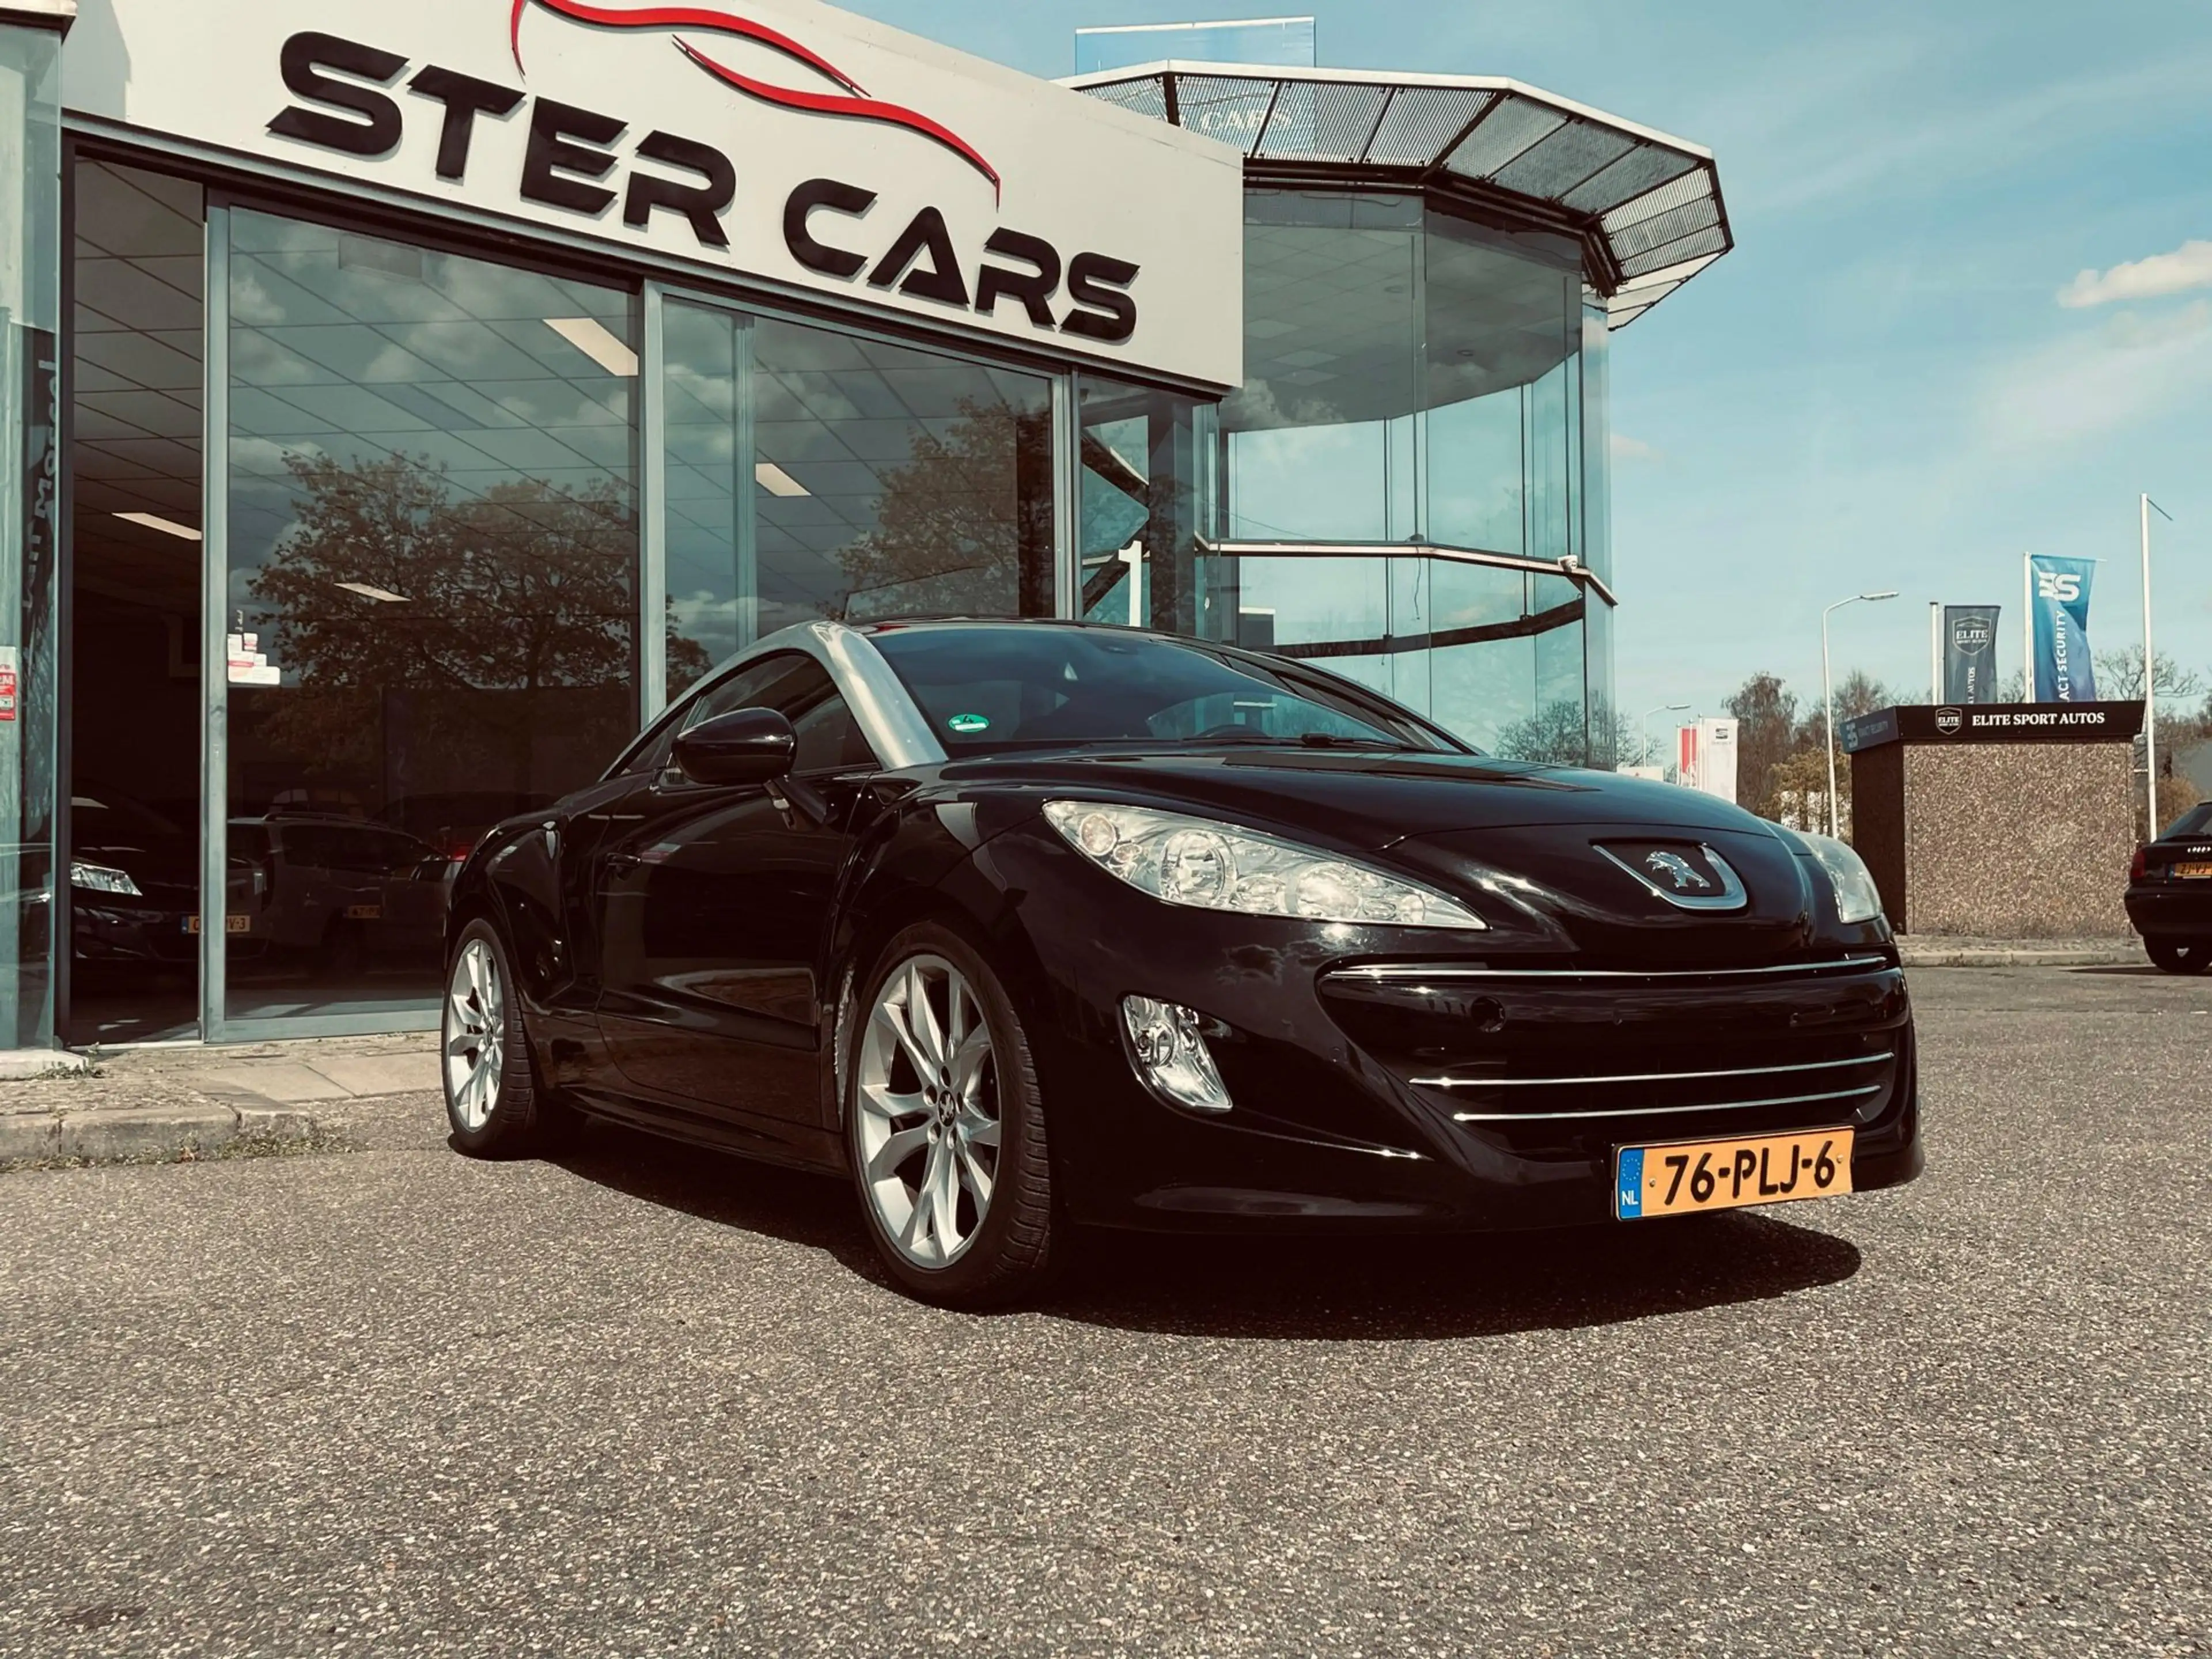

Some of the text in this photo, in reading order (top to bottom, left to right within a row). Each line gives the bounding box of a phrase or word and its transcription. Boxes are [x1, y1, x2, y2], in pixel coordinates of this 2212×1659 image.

[264, 31, 1141, 343] STER CARS
[1956, 630, 1989, 639] ELITE
[2056, 610, 2068, 673] SECURITY
[1967, 666, 1976, 695] AUTOS
[1972, 711, 2105, 726] ELITE SPORT AUTOS
[1664, 1140, 1835, 1206] 76-PLJ-6
[1622, 1190, 1639, 1206] NL
